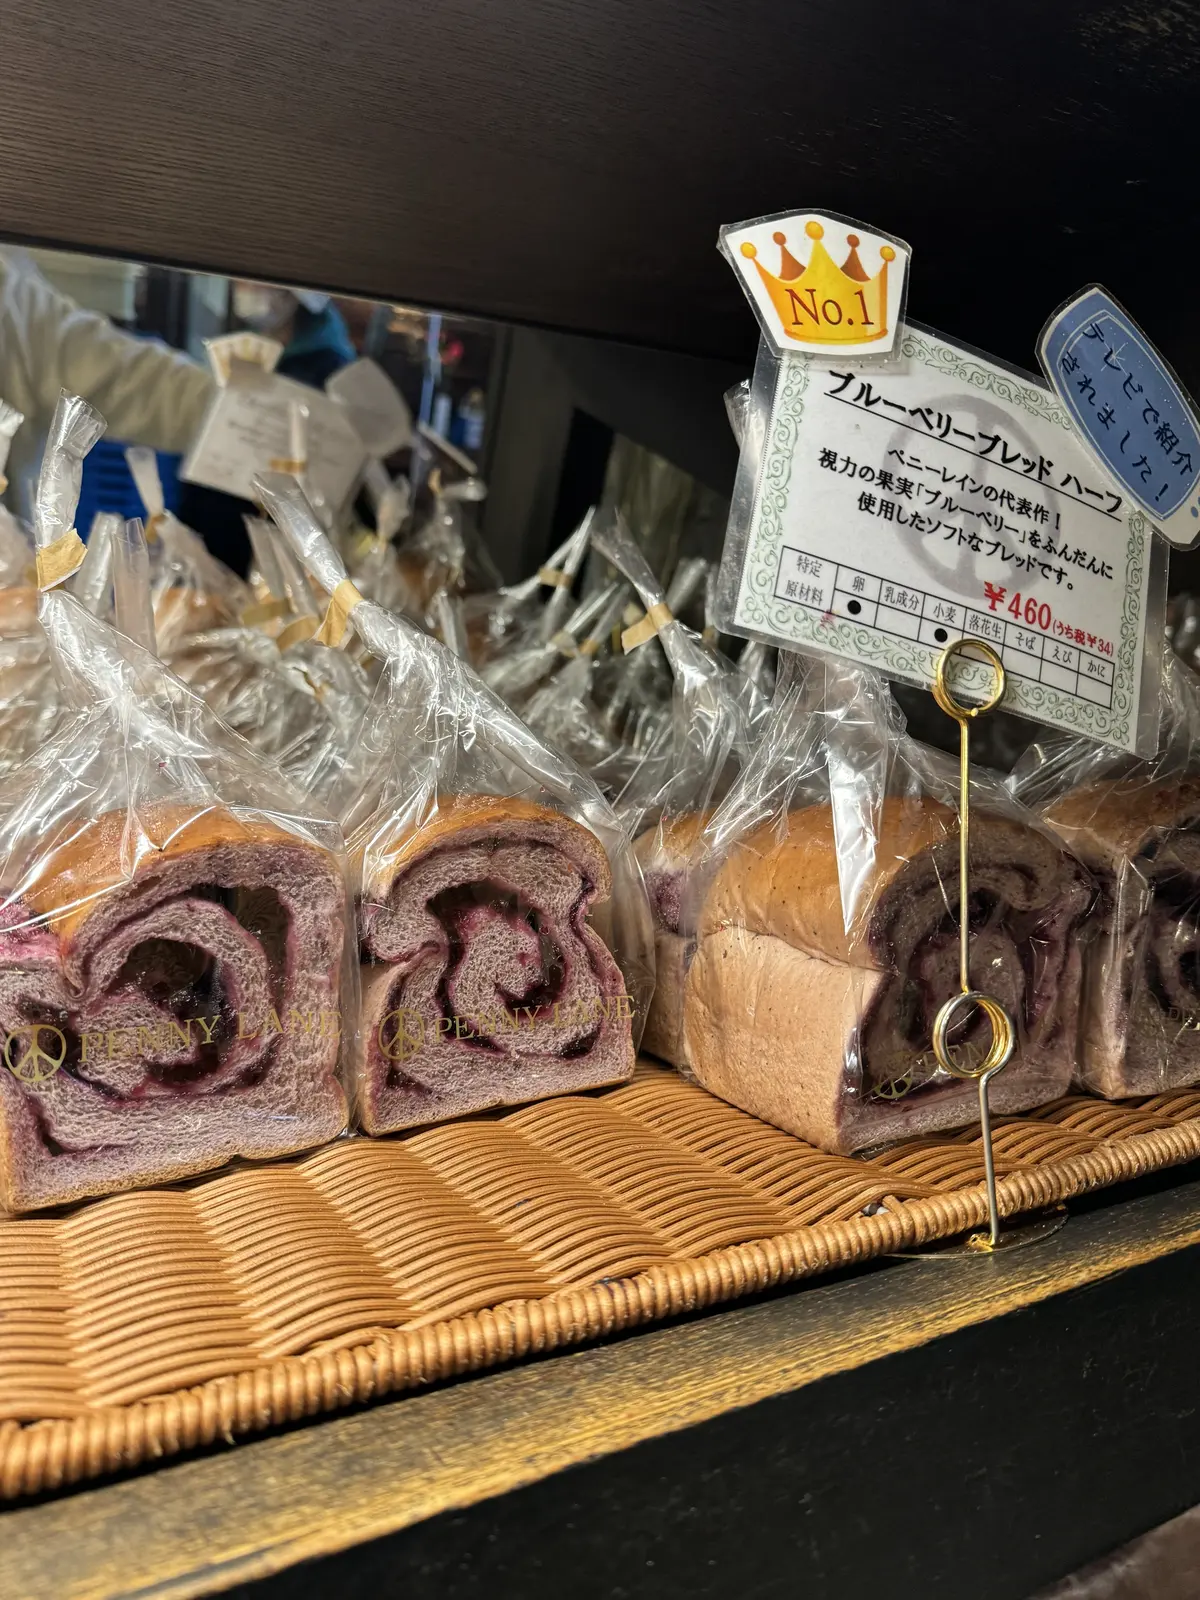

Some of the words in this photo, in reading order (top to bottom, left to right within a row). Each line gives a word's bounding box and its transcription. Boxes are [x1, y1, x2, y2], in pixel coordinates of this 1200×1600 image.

[785, 289, 874, 325] No.1
[829, 370, 1054, 481] ブルーベリーブレッド
[1060, 473, 1123, 513] ハーフ
[1061, 351, 1169, 501] されました！
[1082, 323, 1193, 476] テレビで紹介
[818, 447, 1113, 580] 視力の果実「ブルーベリー」をふんだんに
[888, 449, 1061, 530] ペニーレインの代表作！
[796, 555, 823, 578] 特定
[857, 491, 1074, 591] 使用したソフトなブレッドです。
[785, 579, 824, 606] 原材料
[852, 575, 866, 593] 卵
[884, 586, 920, 611] 乳成分
[933, 603, 957, 624] 小麦
[968, 613, 1002, 639] 落花生
[1015, 631, 1037, 651] そば
[1052, 645, 1073, 664] えび
[1087, 659, 1106, 678] かに
[79, 1016, 221, 1063] PENNY
[237, 1009, 342, 1041] LANE
[434, 1004, 543, 1043] PENNY
[553, 995, 636, 1028] LANE
